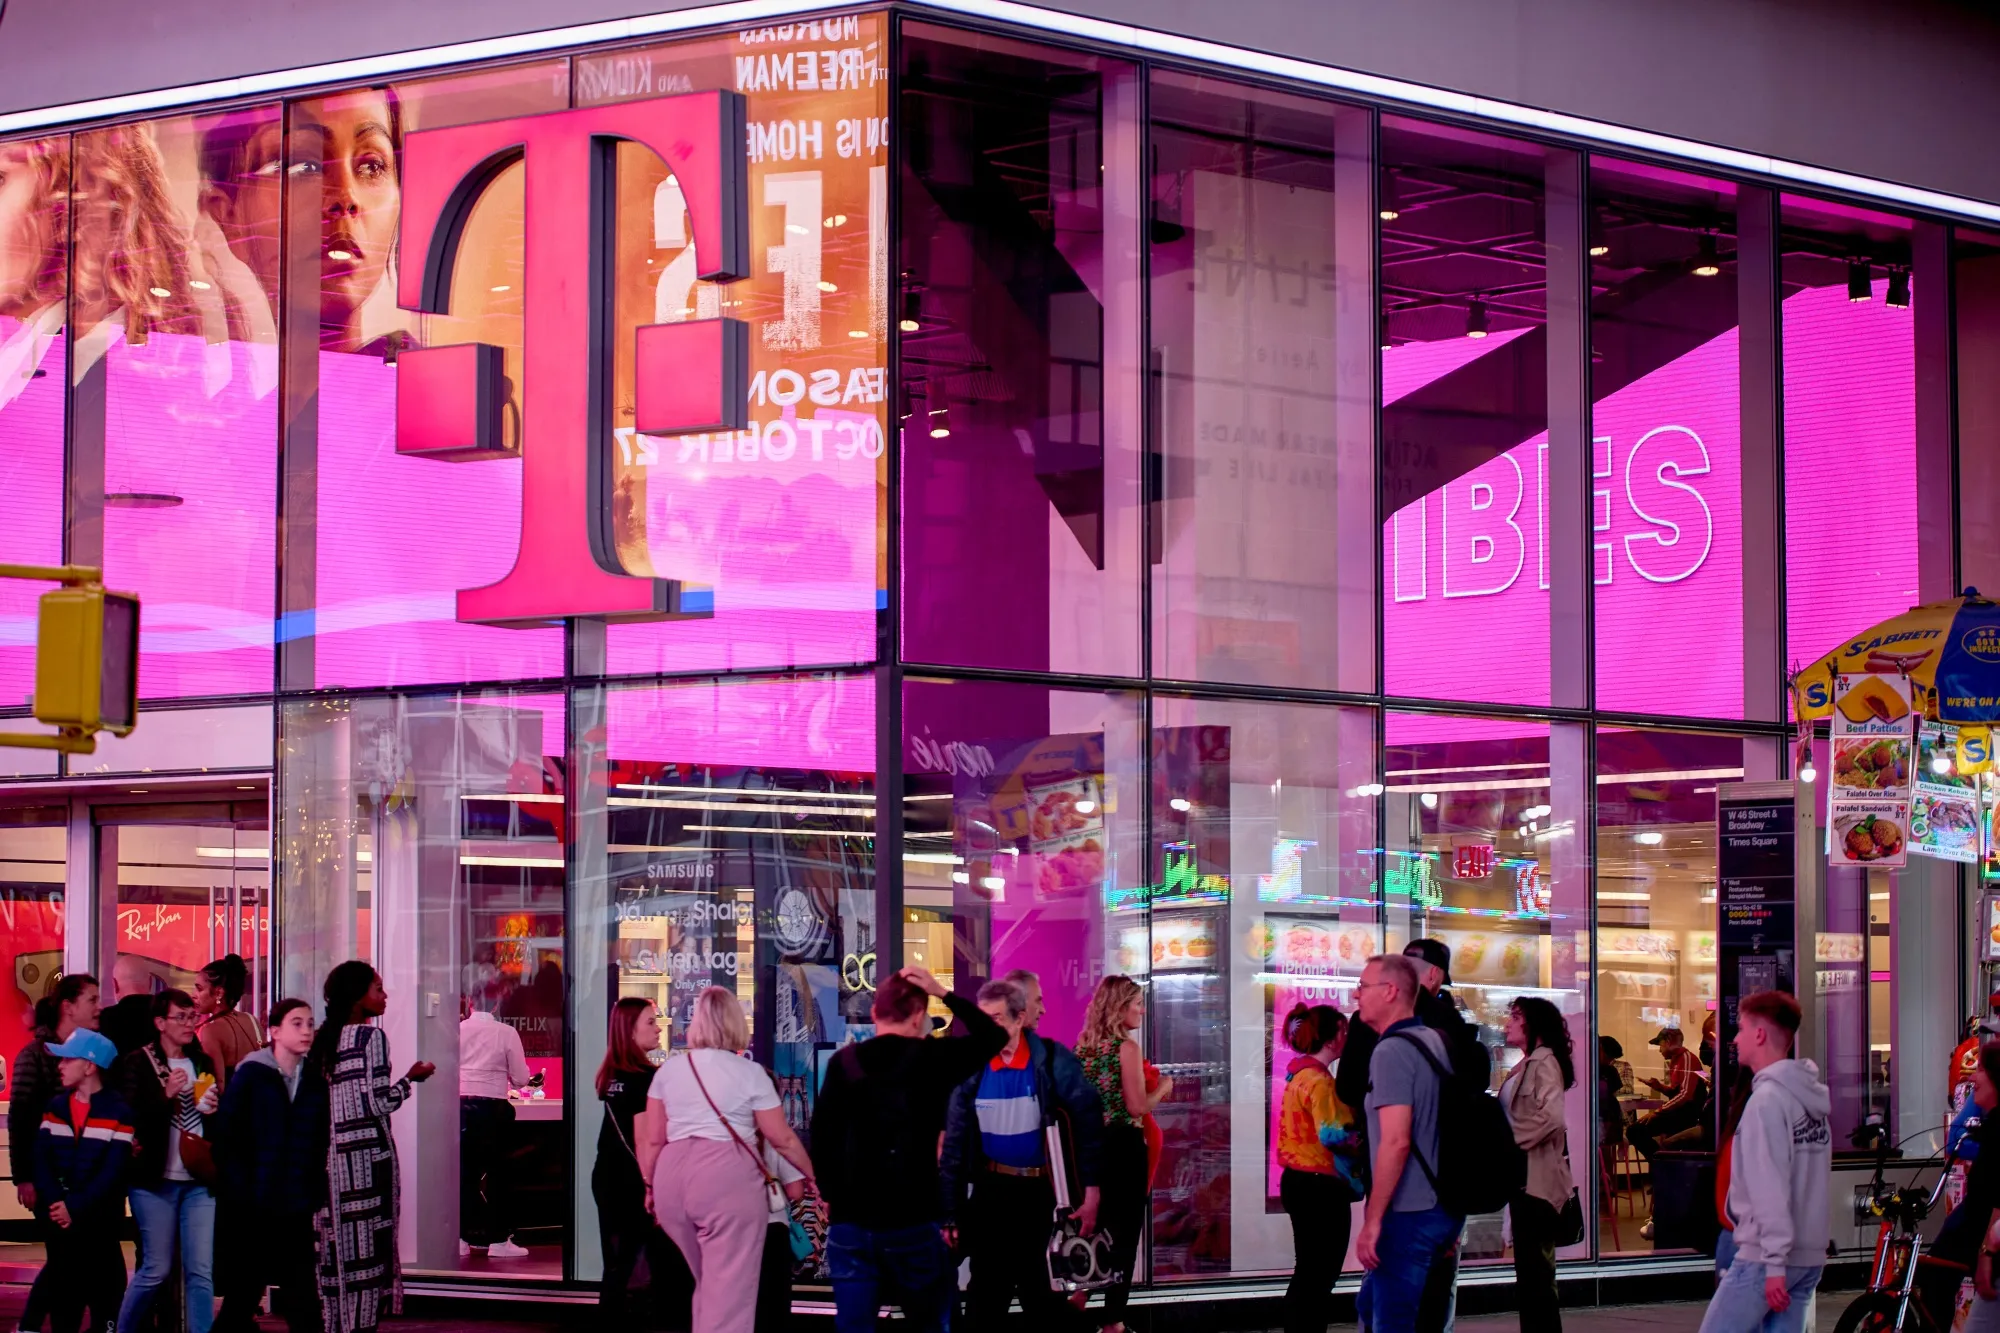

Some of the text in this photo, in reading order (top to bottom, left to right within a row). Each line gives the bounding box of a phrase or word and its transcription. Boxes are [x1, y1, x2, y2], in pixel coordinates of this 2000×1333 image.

[395, 89, 748, 626] T
[1844, 629, 1942, 657] SABRETT
[1846, 724, 1903, 733] Beef Patties
[1920, 783, 1946, 792] Chicken
[1728, 811, 1736, 820] W
[1737, 810, 1747, 819] 46
[1748, 810, 1771, 819] Street
[1728, 821, 1765, 831] Broadway
[1728, 837, 1777, 847] Times Square
[647, 864, 714, 878] SAMSUNG
[674, 979, 695, 992] Only
[499, 1016, 547, 1031] ETFLIX
